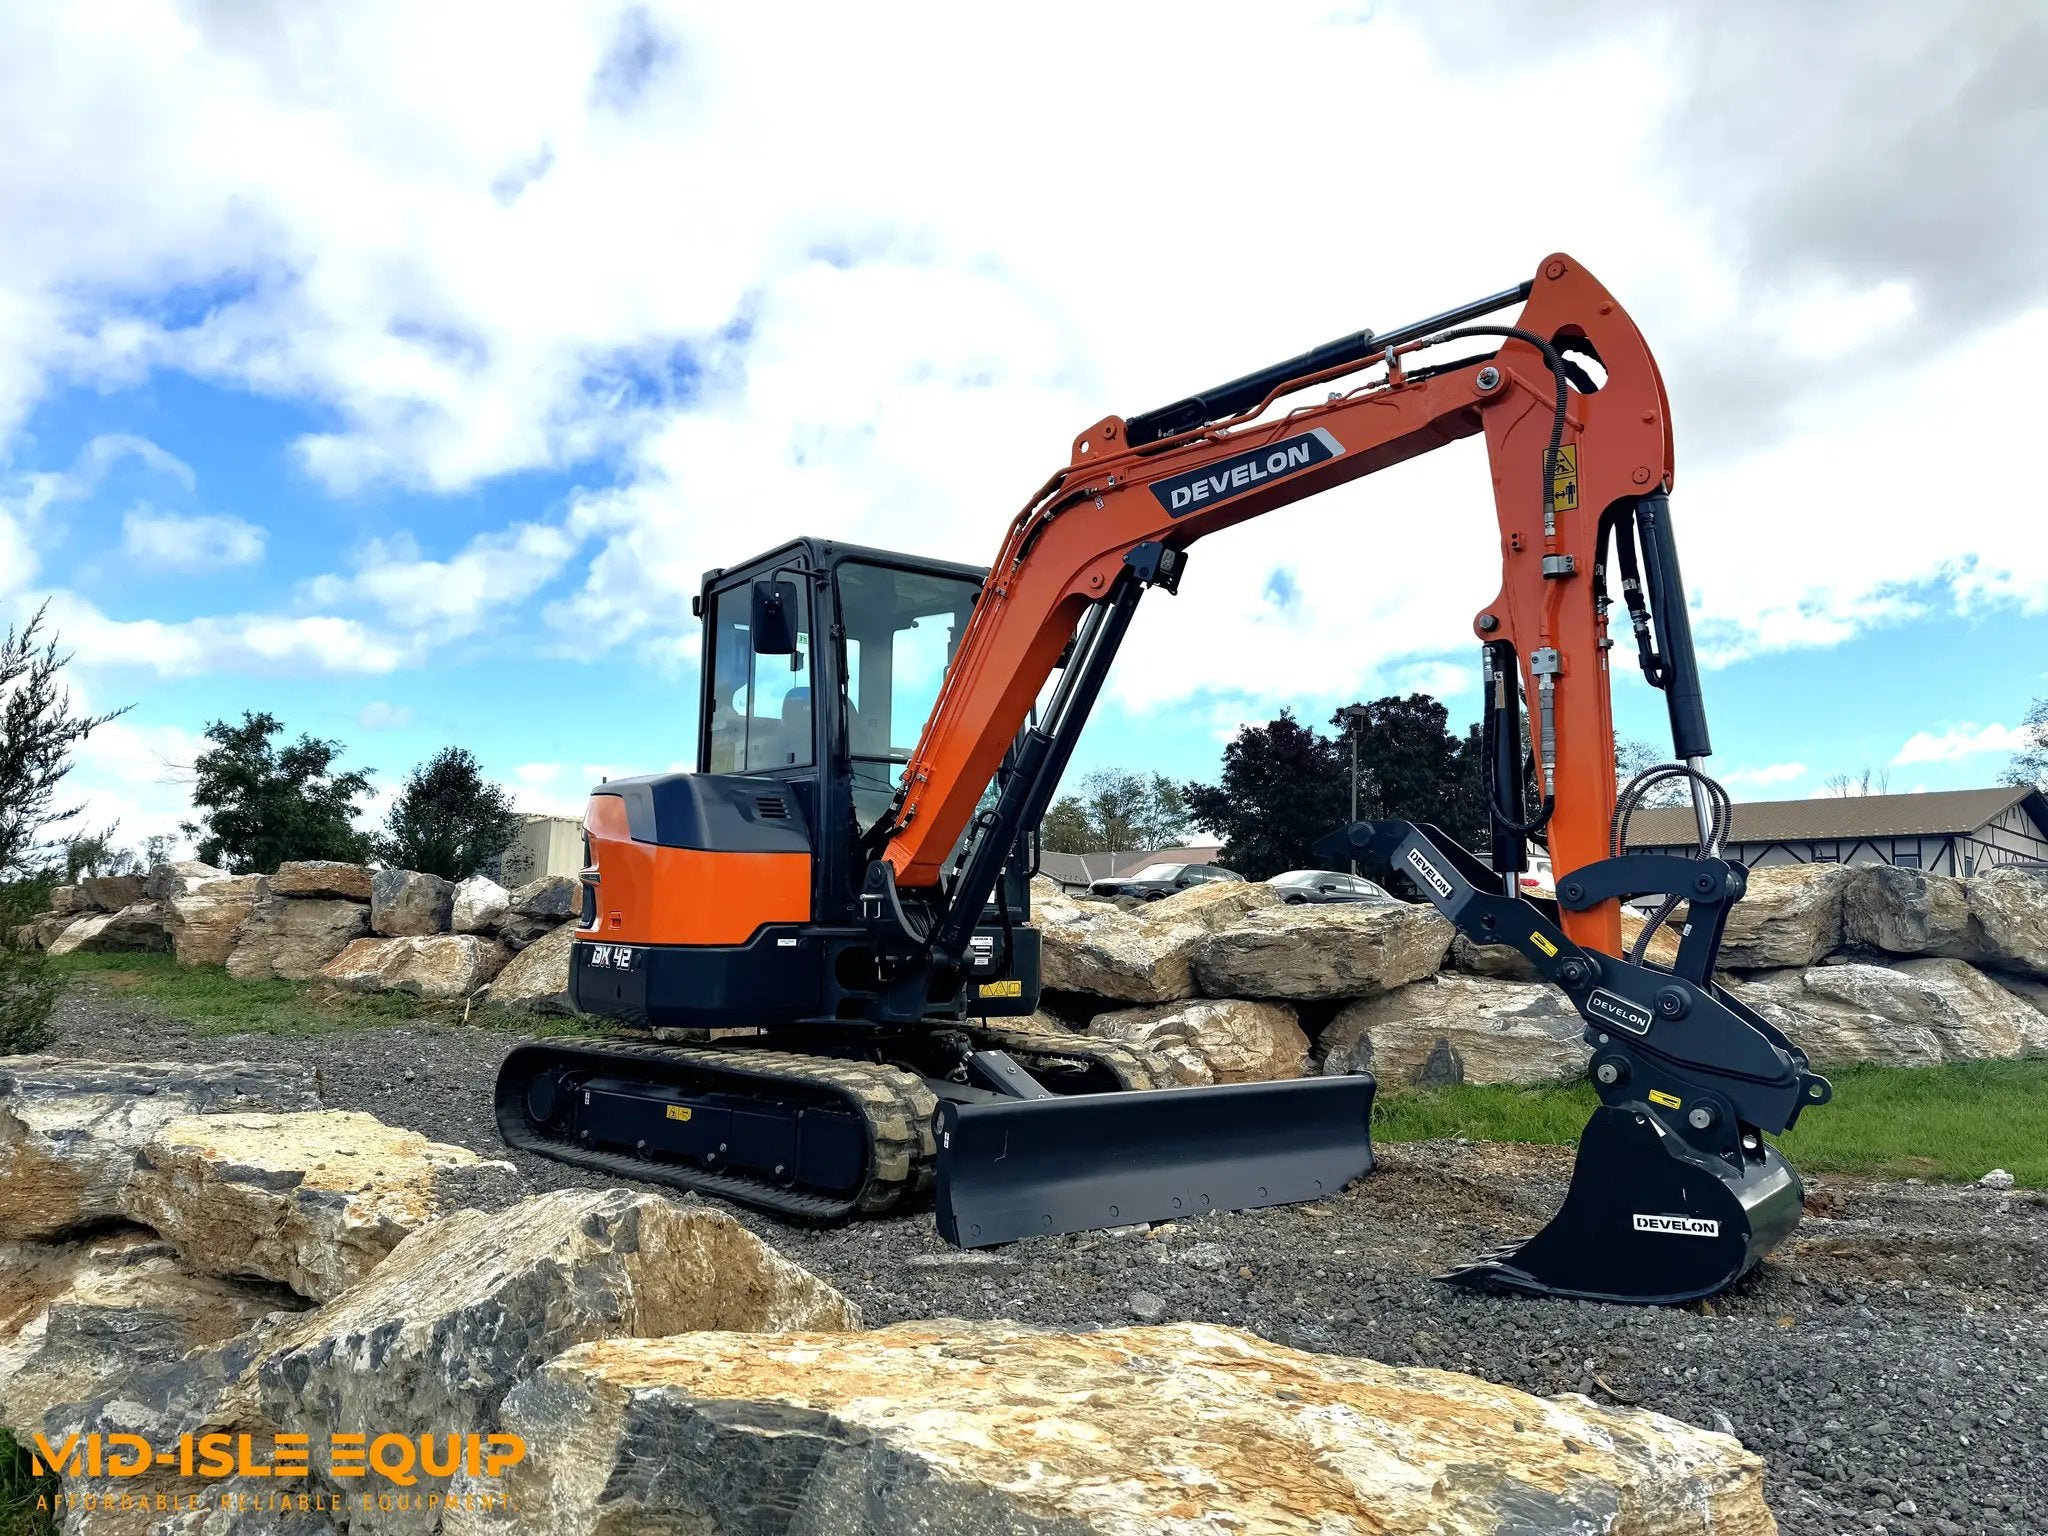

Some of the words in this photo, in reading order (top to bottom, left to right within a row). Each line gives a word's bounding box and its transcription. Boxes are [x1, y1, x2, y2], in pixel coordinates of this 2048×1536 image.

[1170, 442, 1310, 509] DEVELON
[1410, 852, 1449, 894] DEVELON
[613, 947, 632, 970] 42
[1593, 997, 1646, 1026] DEVELON
[1636, 1217, 1715, 1233] DEVELON
